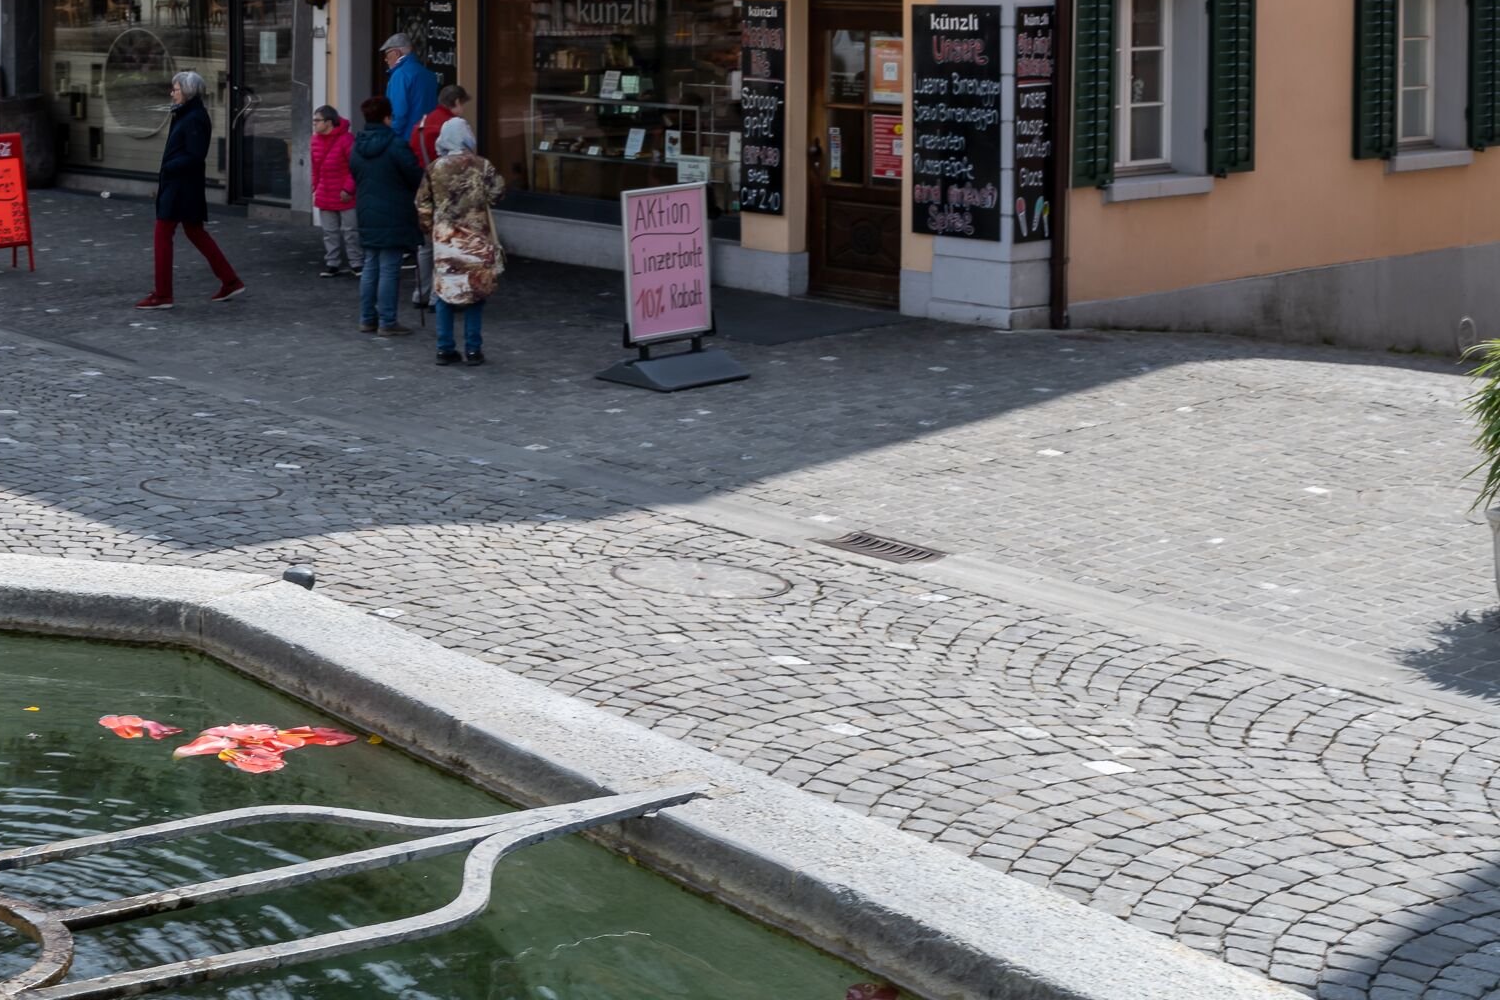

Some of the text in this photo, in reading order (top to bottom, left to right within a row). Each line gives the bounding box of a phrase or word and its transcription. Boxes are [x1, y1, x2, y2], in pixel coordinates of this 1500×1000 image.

[748, 6, 777, 18] künzli
[930, 13, 979, 31] künzli
[932, 35, 990, 65] Unsere
[632, 238, 703, 275] Linzertorte
[636, 279, 703, 320] 10% Rabatt
